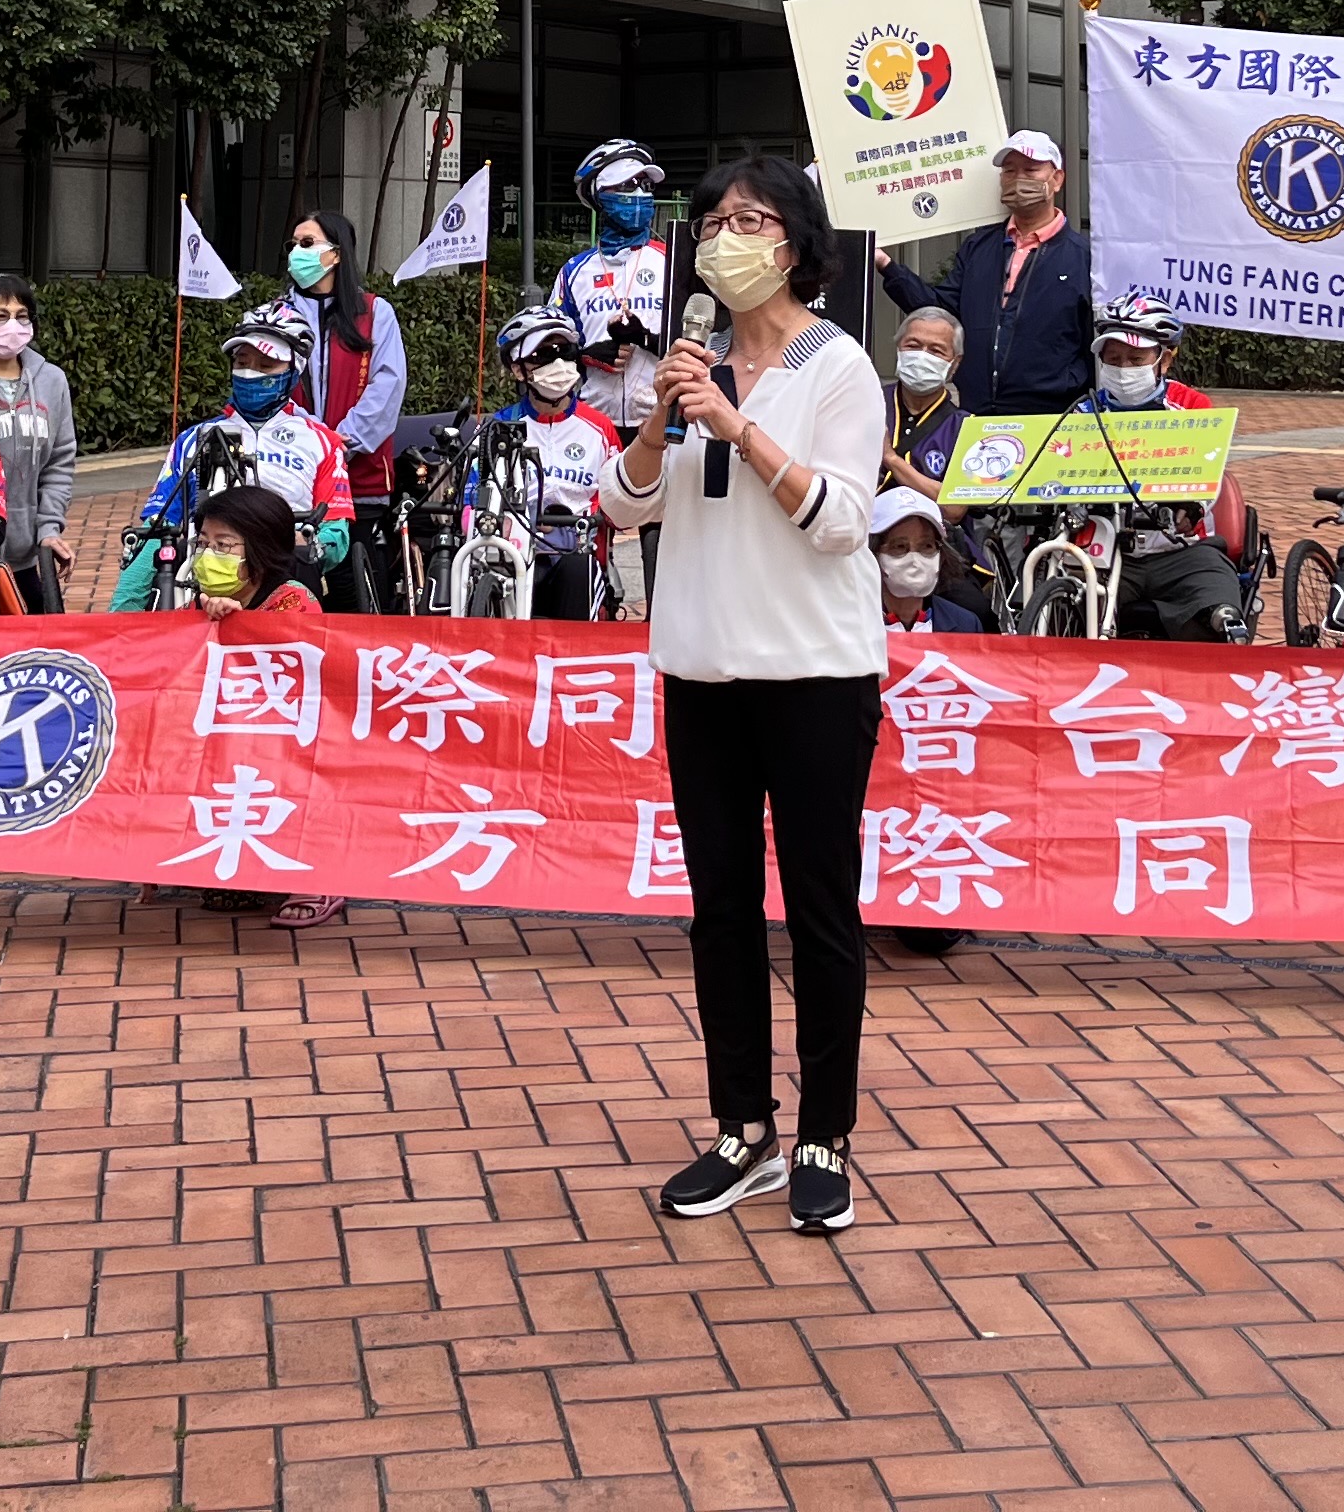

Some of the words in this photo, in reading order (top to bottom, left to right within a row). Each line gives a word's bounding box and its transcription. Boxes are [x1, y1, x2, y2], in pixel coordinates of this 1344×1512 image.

[846, 23, 919, 70] KIWANIS
[856, 131, 968, 163] 國際同濟會台灣總會
[876, 168, 964, 196] 東方國際同濟會
[1276, 139, 1332, 211] K
[1164, 258, 1233, 285] TUNG
[1243, 266, 1320, 294] FANG
[255, 448, 306, 472] anis
